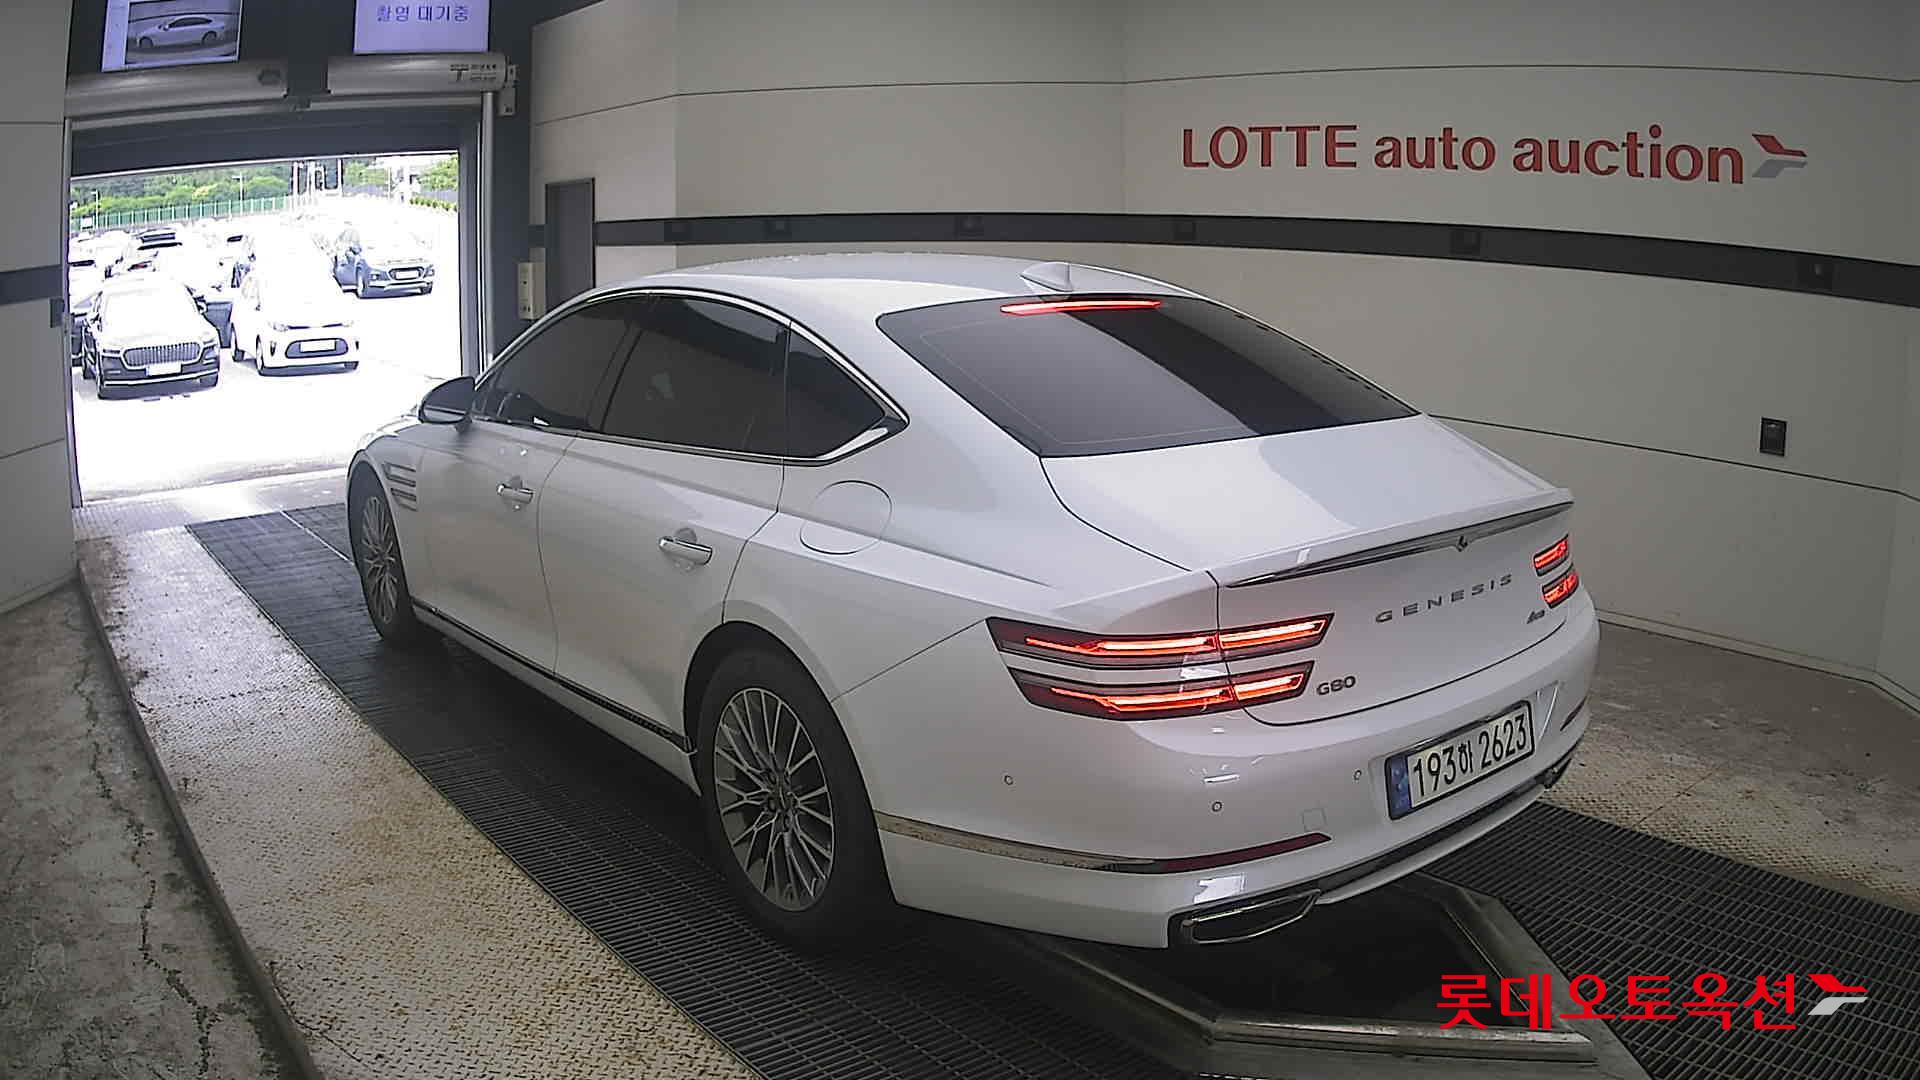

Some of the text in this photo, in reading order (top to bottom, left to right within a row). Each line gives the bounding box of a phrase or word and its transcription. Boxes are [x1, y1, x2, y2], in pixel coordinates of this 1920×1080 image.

[417, 5, 468, 22] 대기중
[1183, 124, 1743, 184] LOTTE auto auction
[1375, 573, 1513, 624] GENESIS
[1316, 675, 1356, 696] G80
[1413, 713, 1528, 797] 193하 2623
